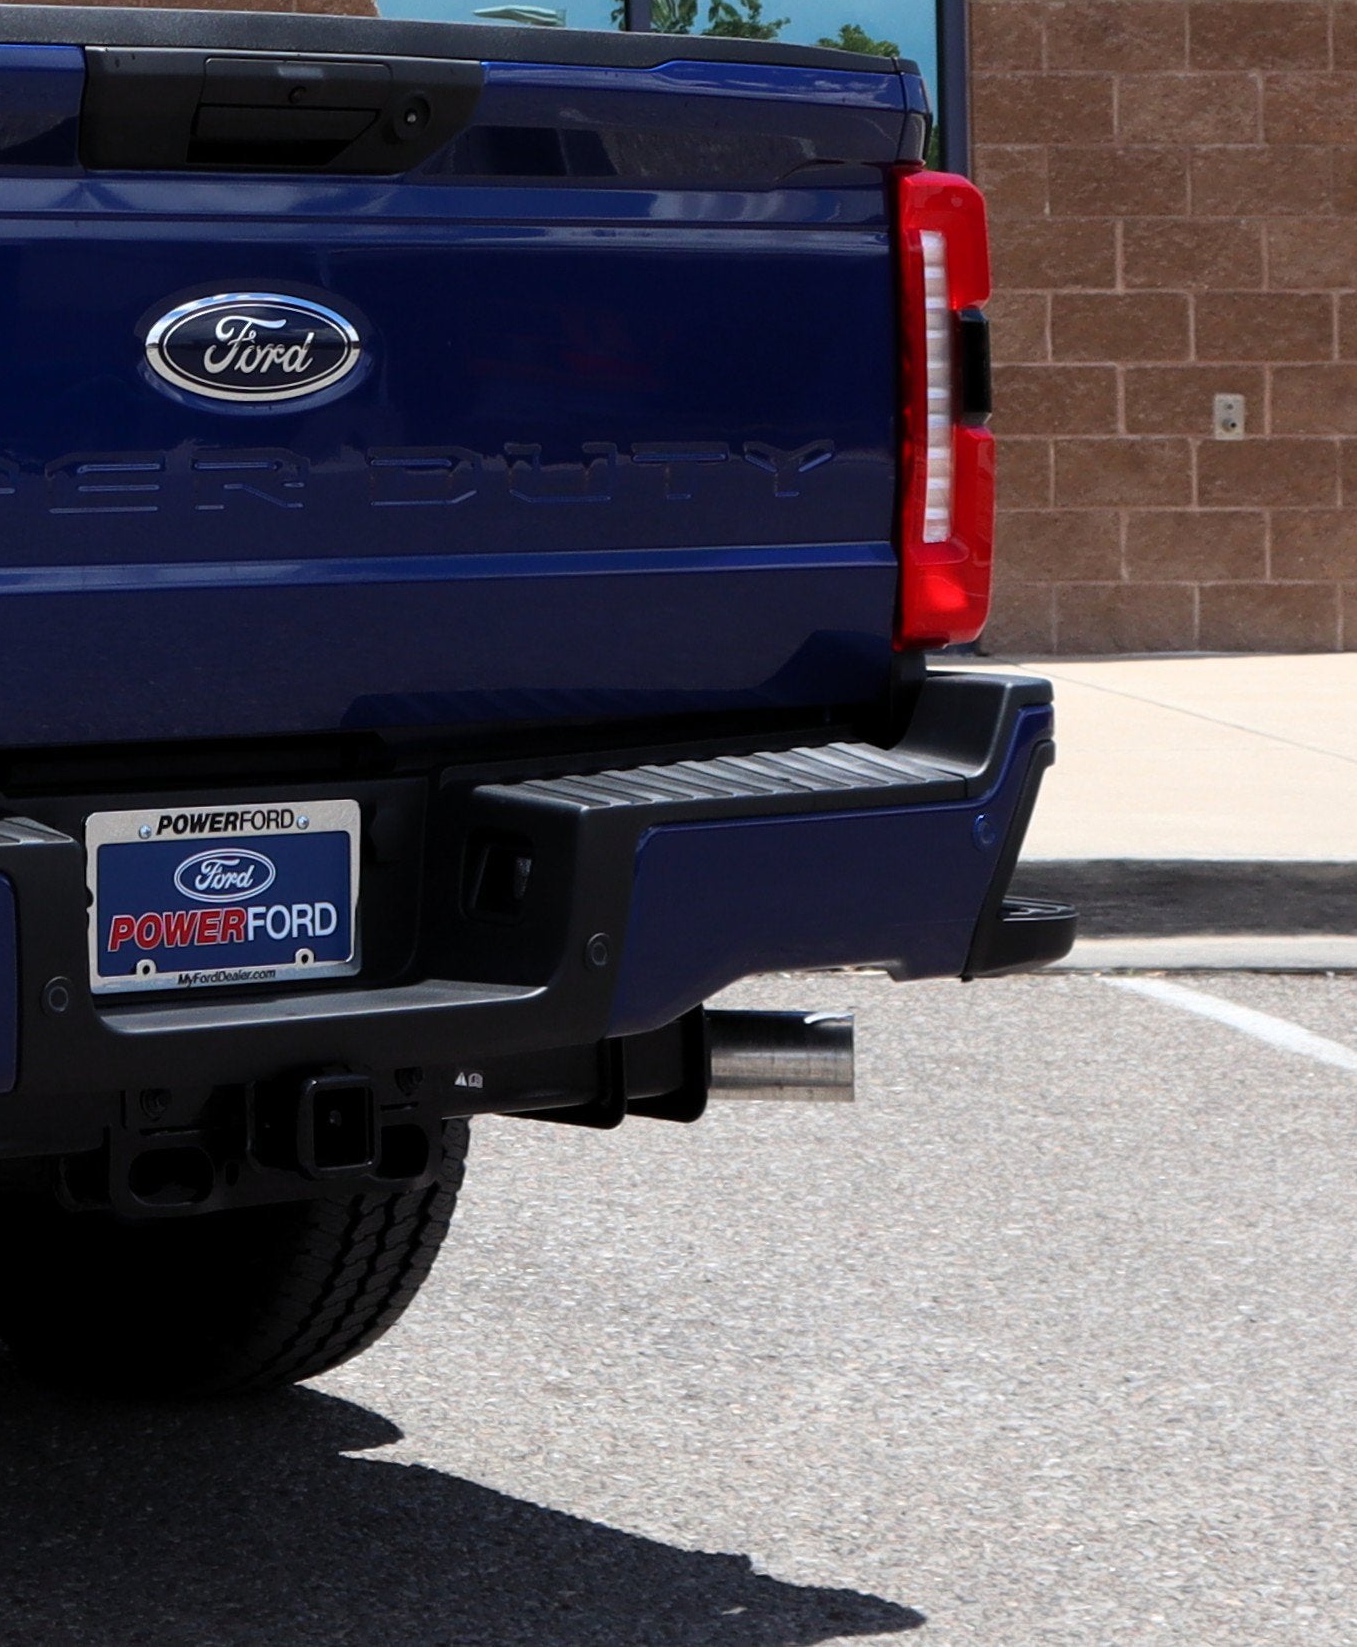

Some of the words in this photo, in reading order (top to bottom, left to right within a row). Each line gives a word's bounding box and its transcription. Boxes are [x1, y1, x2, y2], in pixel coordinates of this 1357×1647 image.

[203, 314, 315, 375] Ford
[367, 438, 836, 508] DUTY
[155, 808, 295, 836] POWERFORD
[194, 858, 255, 891] Ford
[107, 902, 338, 952] POWERFORD
[177, 968, 277, 988] MyFordDealer.com
